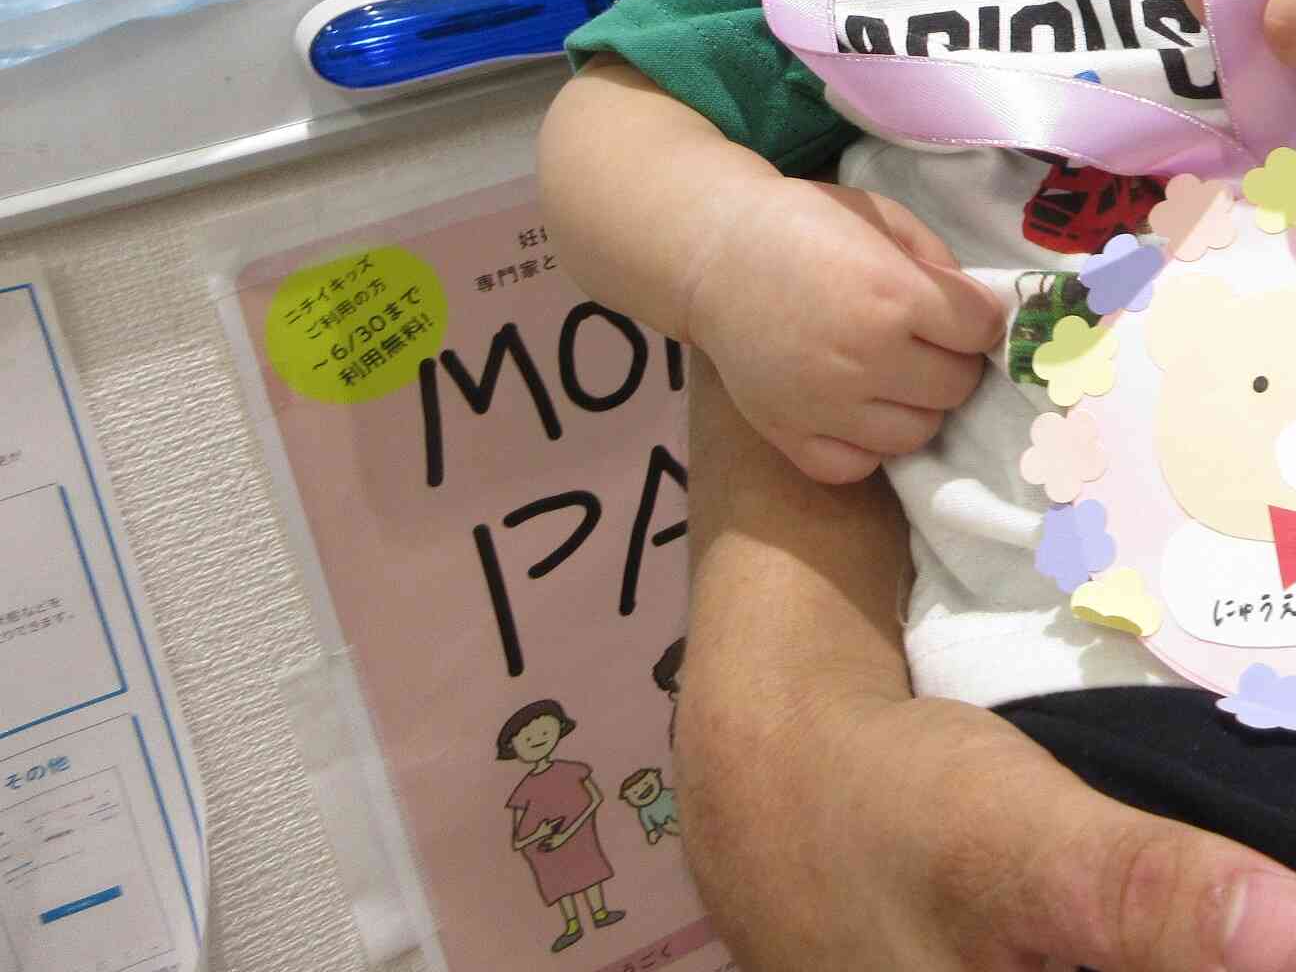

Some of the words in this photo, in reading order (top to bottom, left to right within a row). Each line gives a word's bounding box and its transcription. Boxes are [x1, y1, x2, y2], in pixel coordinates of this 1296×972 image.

[284, 254, 374, 325] ニチイキッズ
[4, 755, 72, 791] その他
